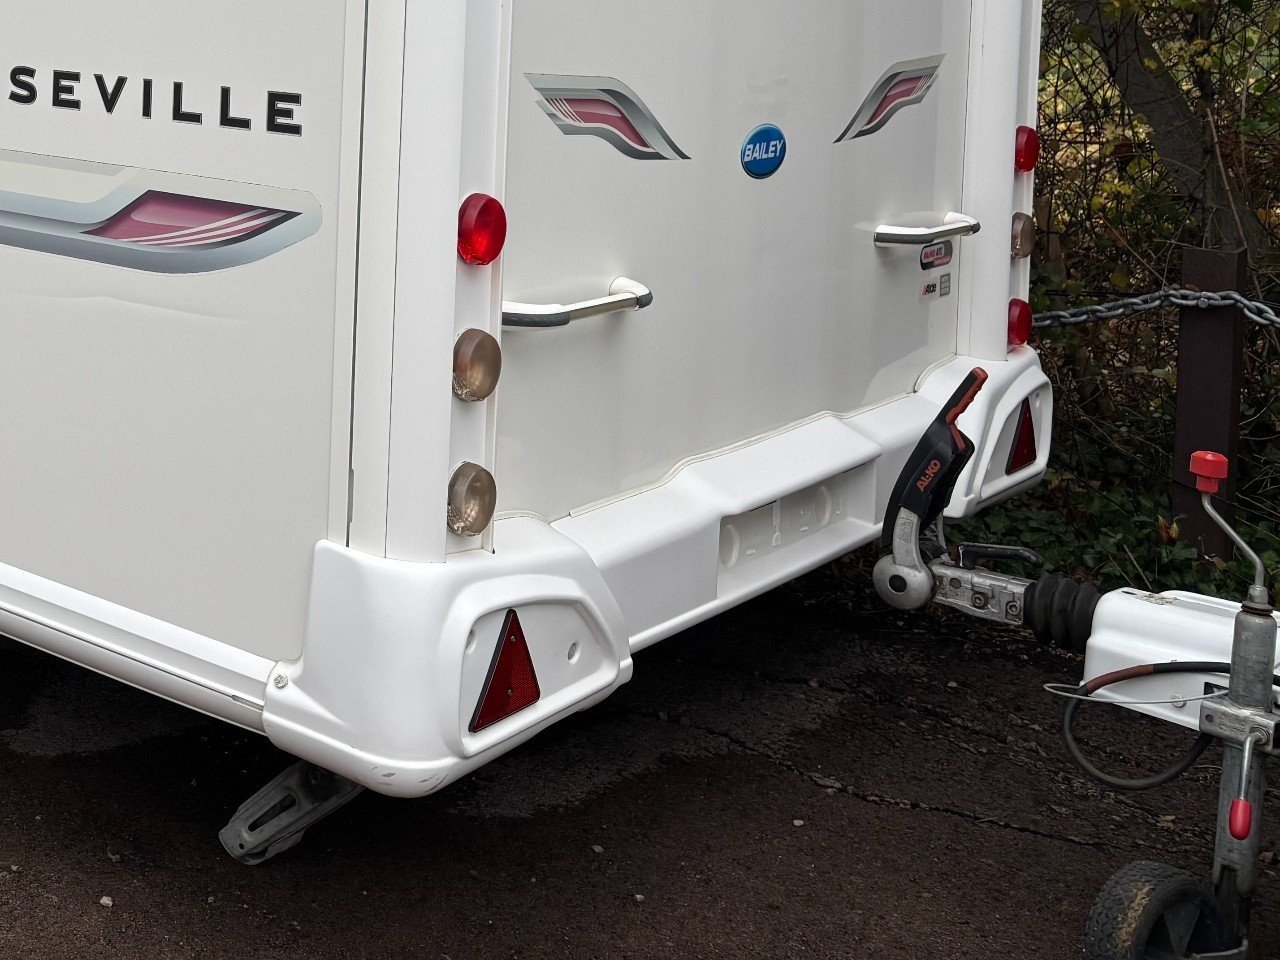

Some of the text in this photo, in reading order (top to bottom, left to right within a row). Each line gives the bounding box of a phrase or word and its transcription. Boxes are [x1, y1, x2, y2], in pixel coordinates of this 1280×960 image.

[8, 65, 303, 138] SEVILLE
[743, 139, 784, 162] BAILEY
[916, 459, 941, 492] AL-KO
